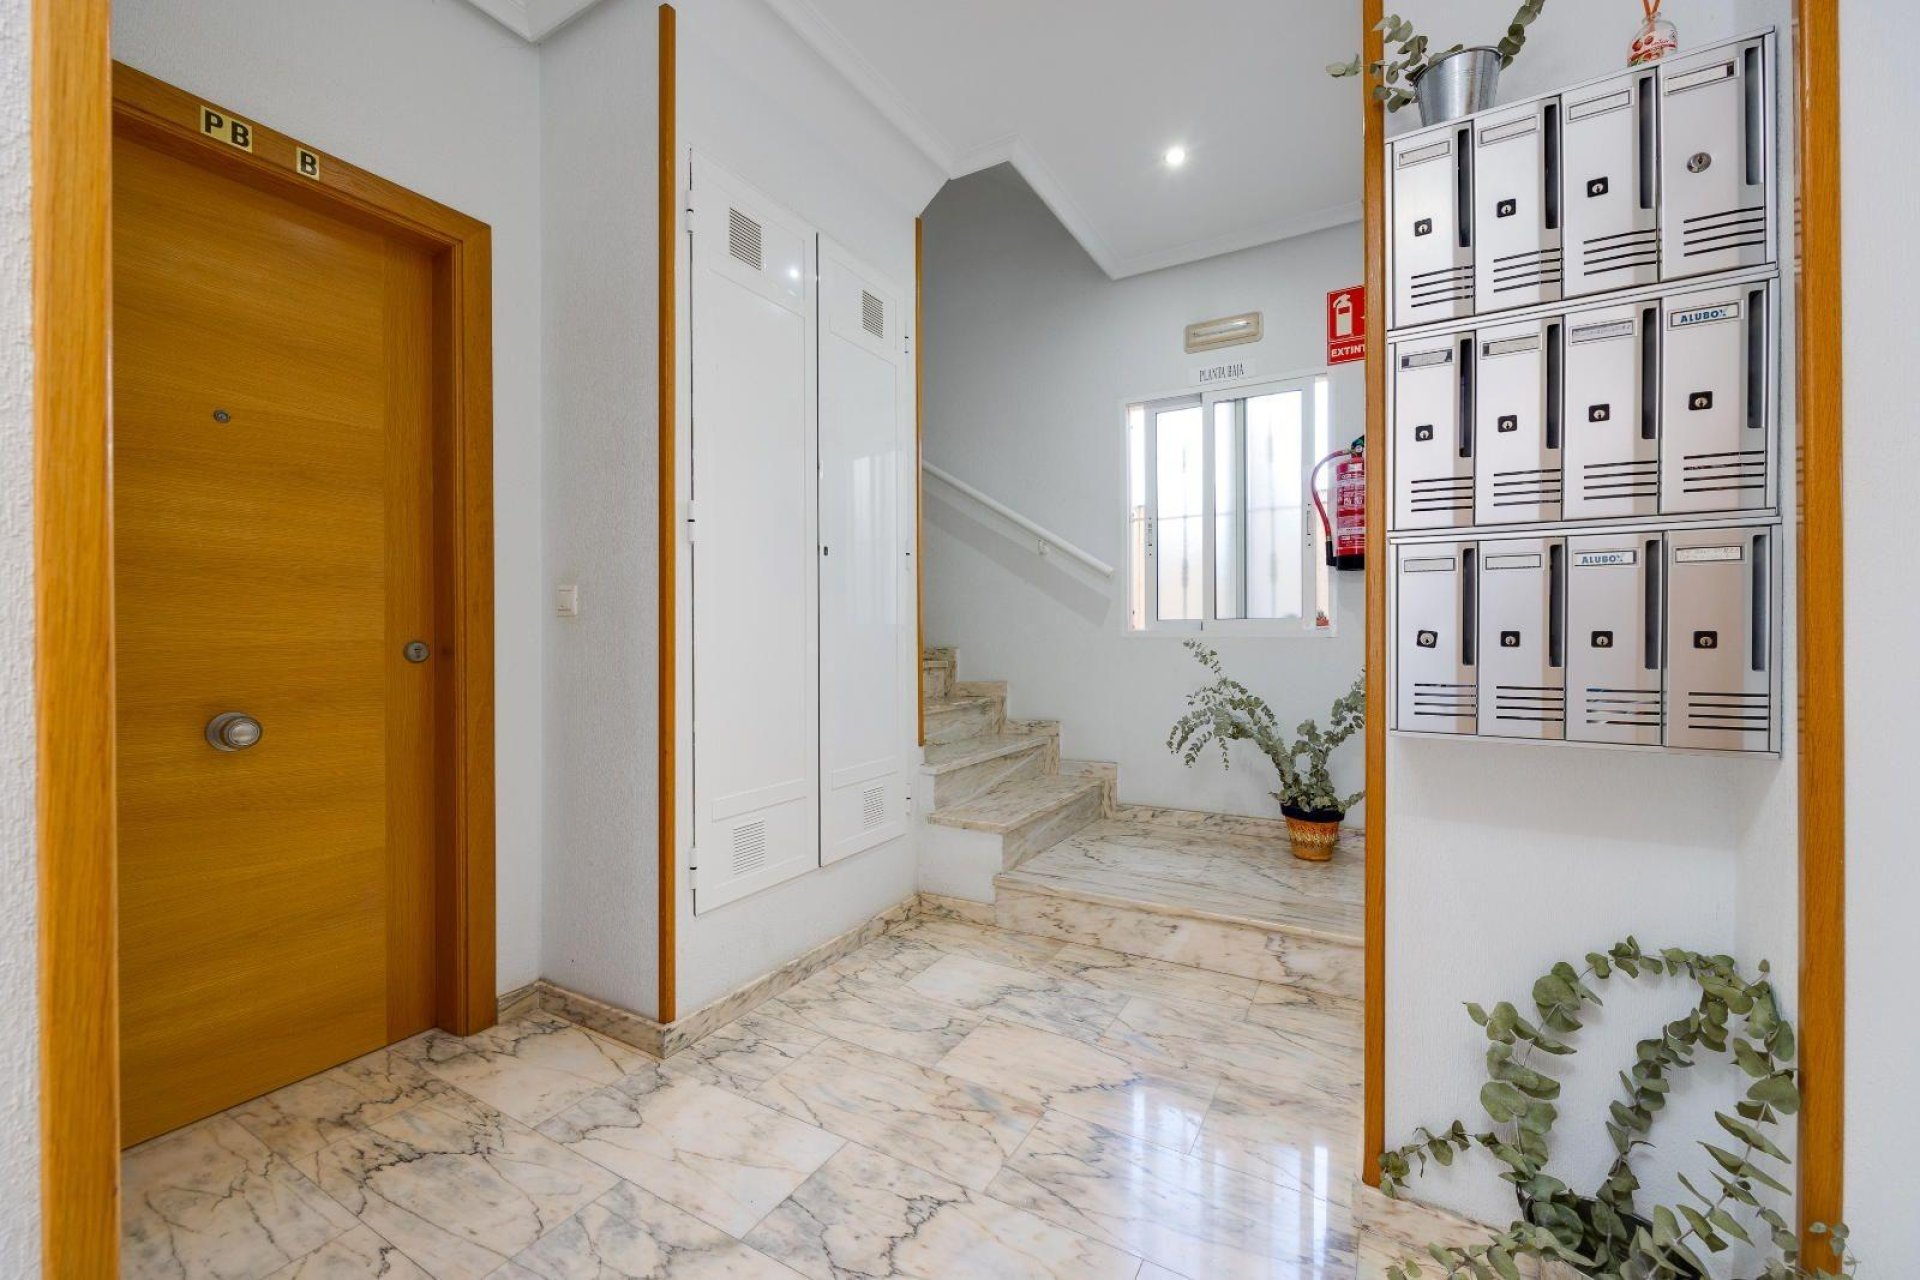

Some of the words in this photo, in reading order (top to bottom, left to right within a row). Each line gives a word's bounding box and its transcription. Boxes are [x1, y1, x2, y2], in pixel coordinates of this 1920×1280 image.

[300, 150, 318, 176] B
[1199, 366, 1226, 382] PLANTA
[1227, 362, 1244, 378] BAJA
